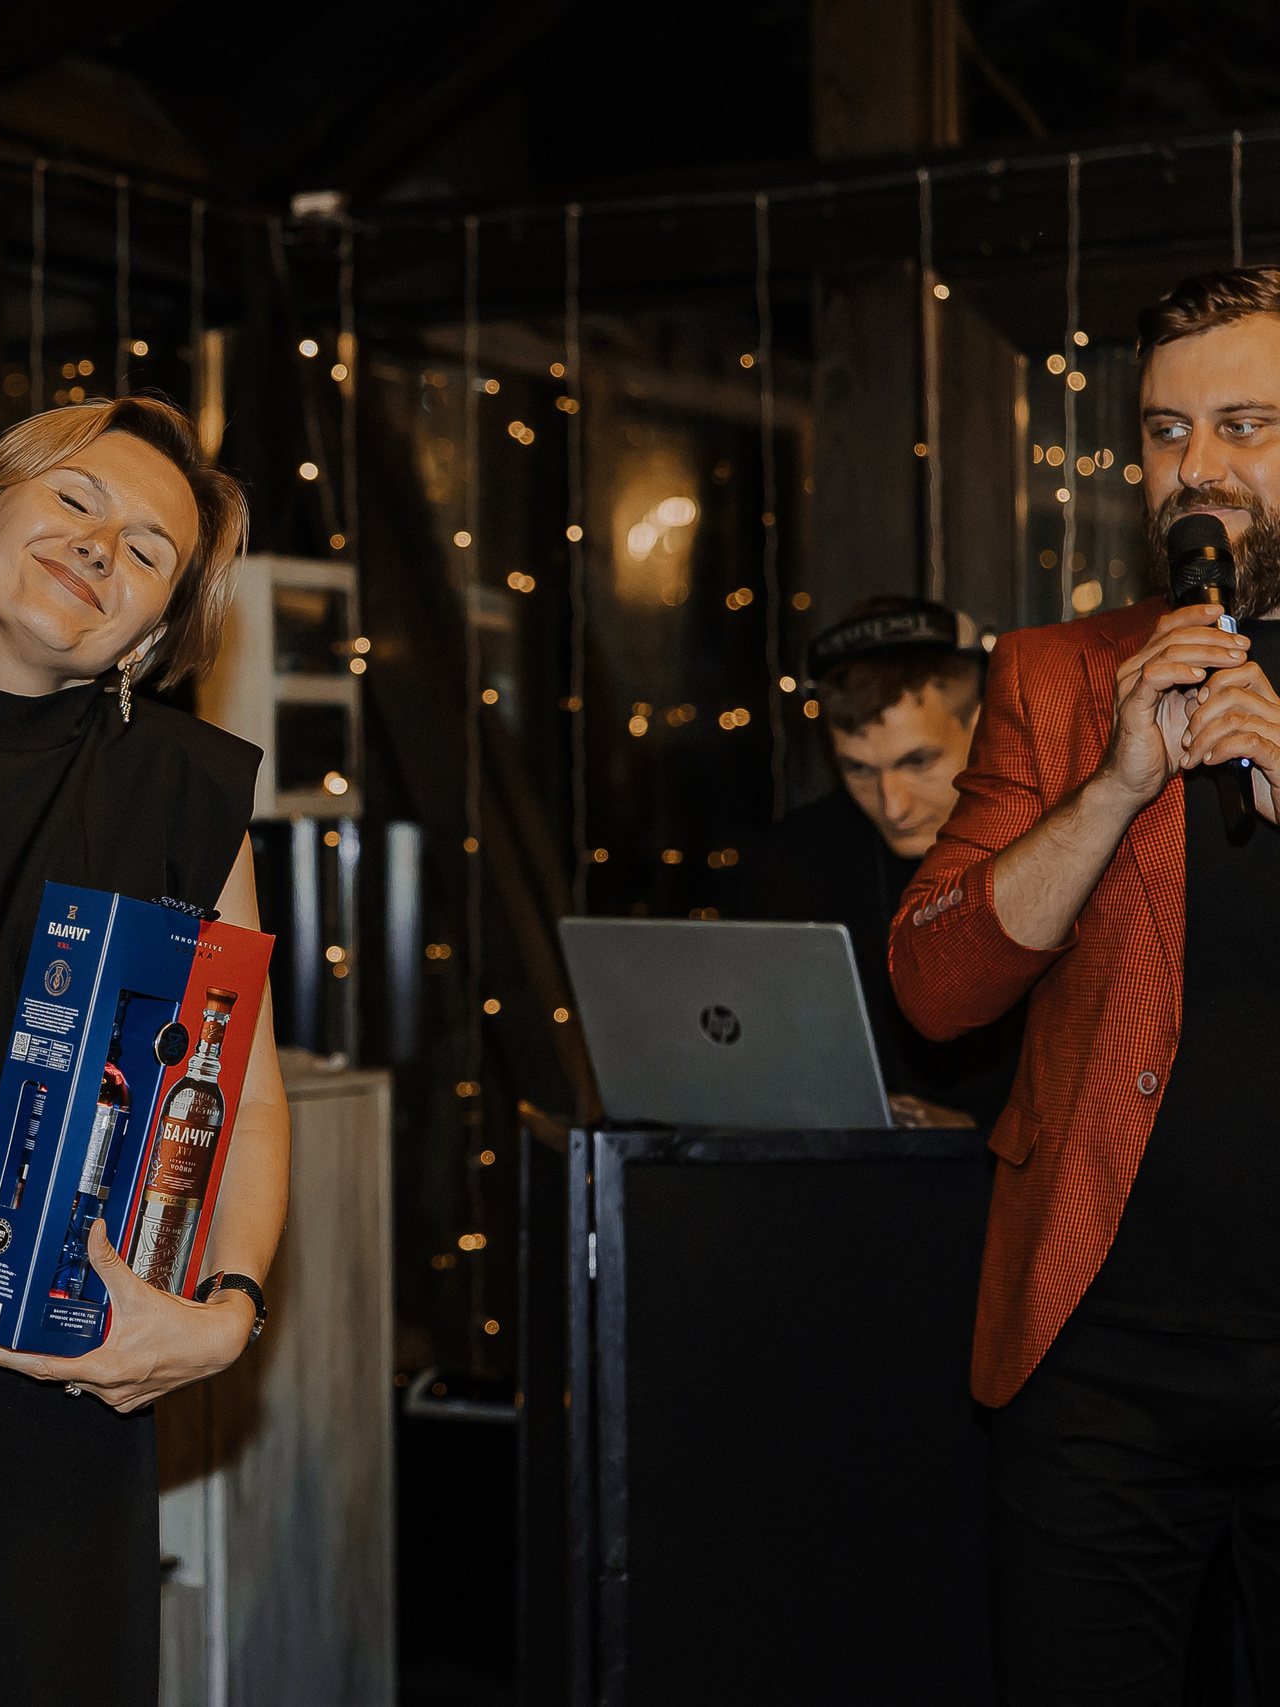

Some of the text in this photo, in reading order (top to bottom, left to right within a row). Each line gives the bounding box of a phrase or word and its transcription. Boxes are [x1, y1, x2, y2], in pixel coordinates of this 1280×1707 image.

[47, 921, 91, 942] БАЛЧУГ
[170, 934, 223, 952] INNOVATIVE
[175, 945, 213, 960] VODKA
[163, 1122, 215, 1148] БАЛЧУГ
